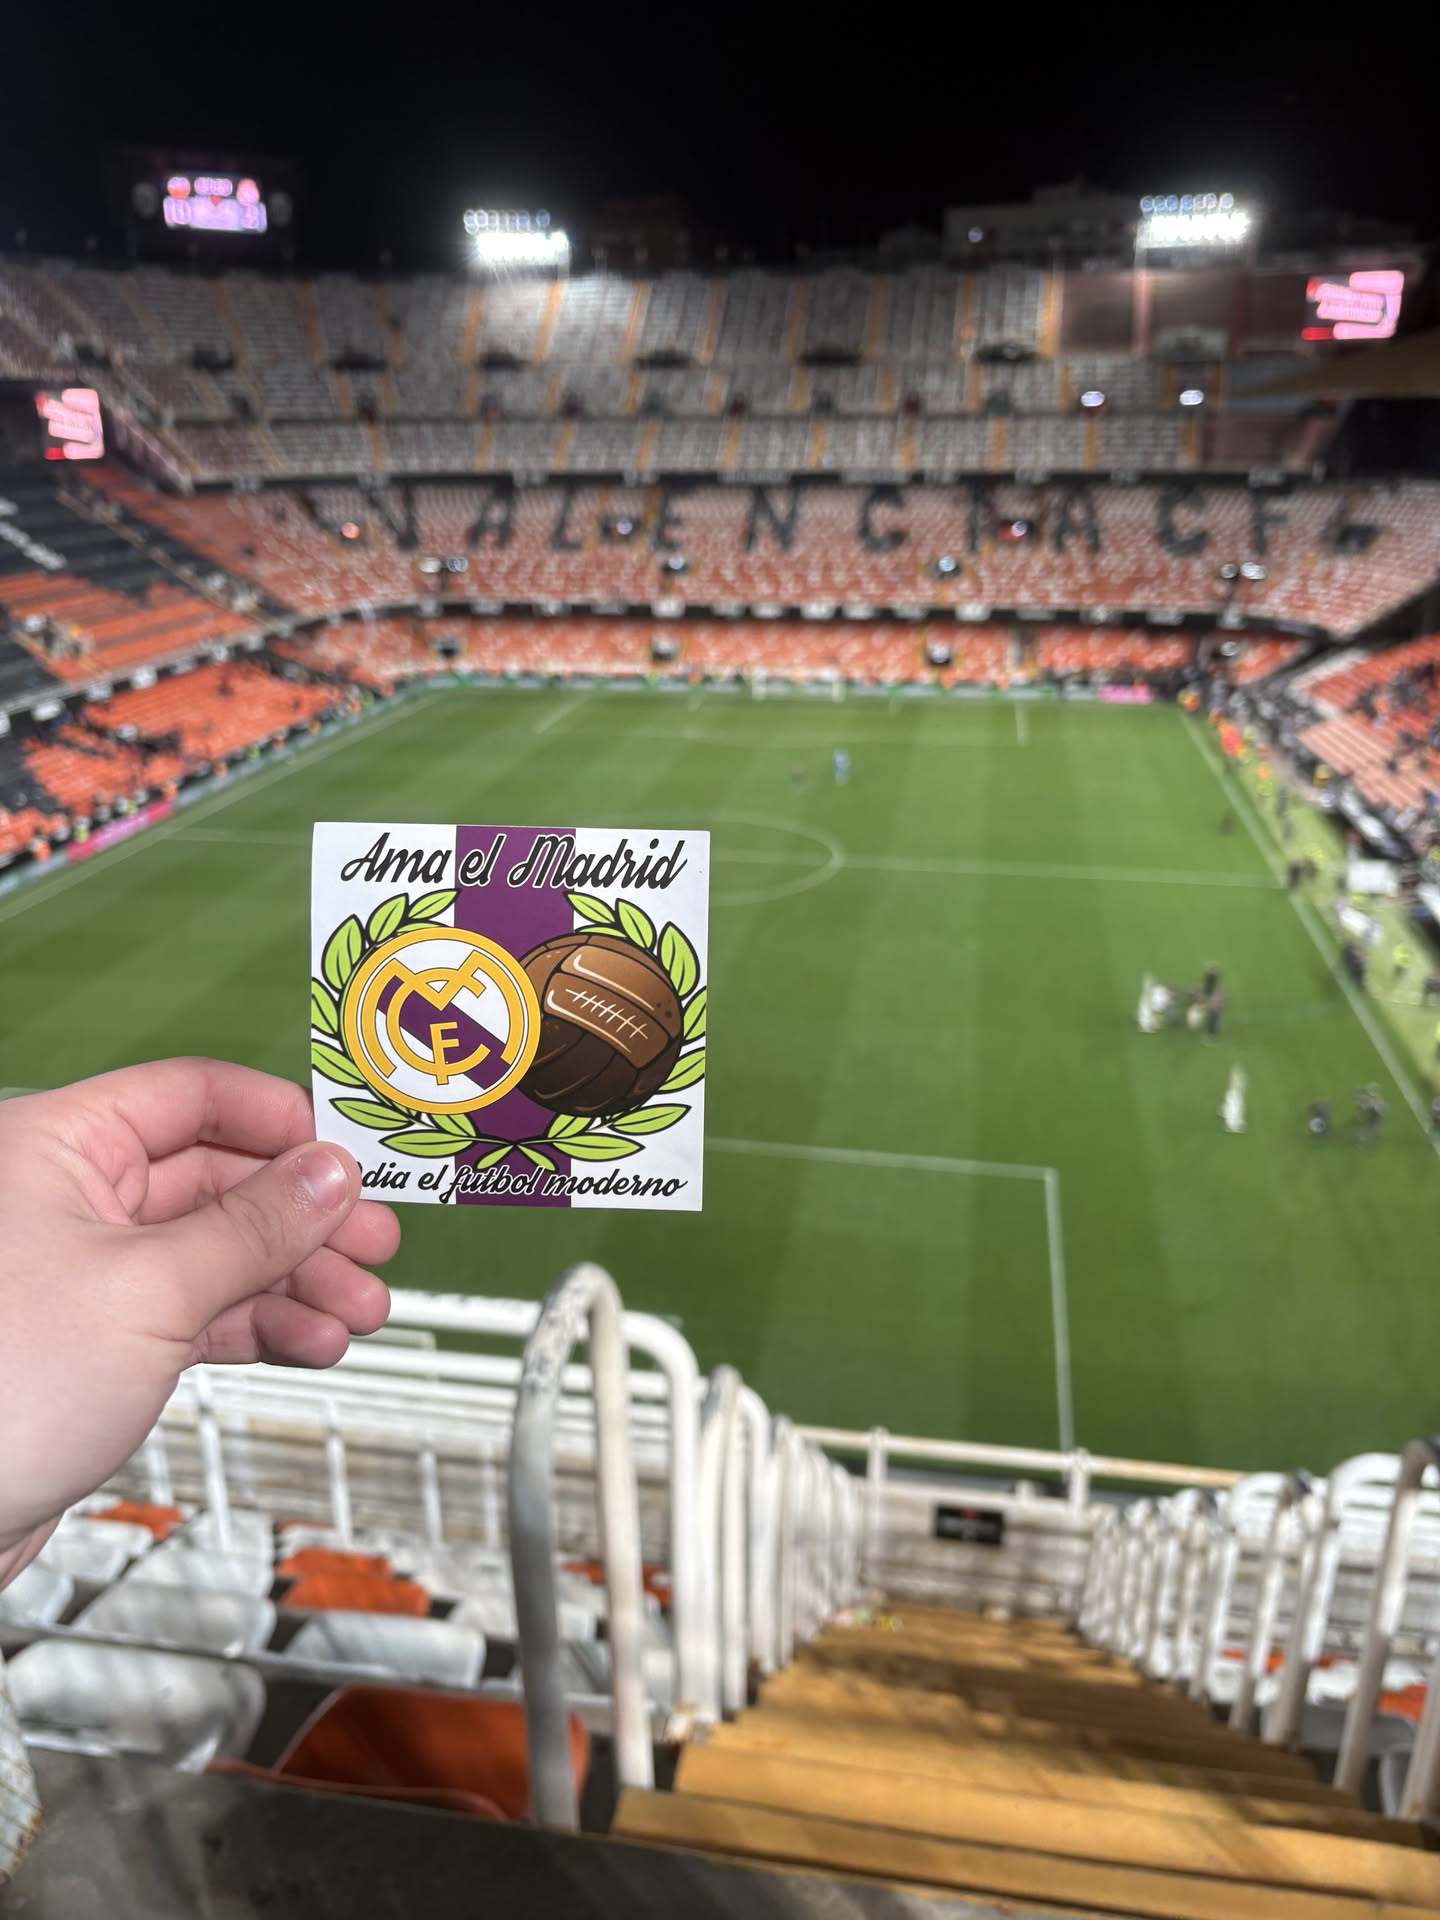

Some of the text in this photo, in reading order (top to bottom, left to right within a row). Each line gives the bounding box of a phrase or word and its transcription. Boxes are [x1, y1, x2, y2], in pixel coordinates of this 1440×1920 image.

[341, 832, 688, 890] Ama el Madrid
[357, 1161, 688, 1204] dia el futbol moderno
